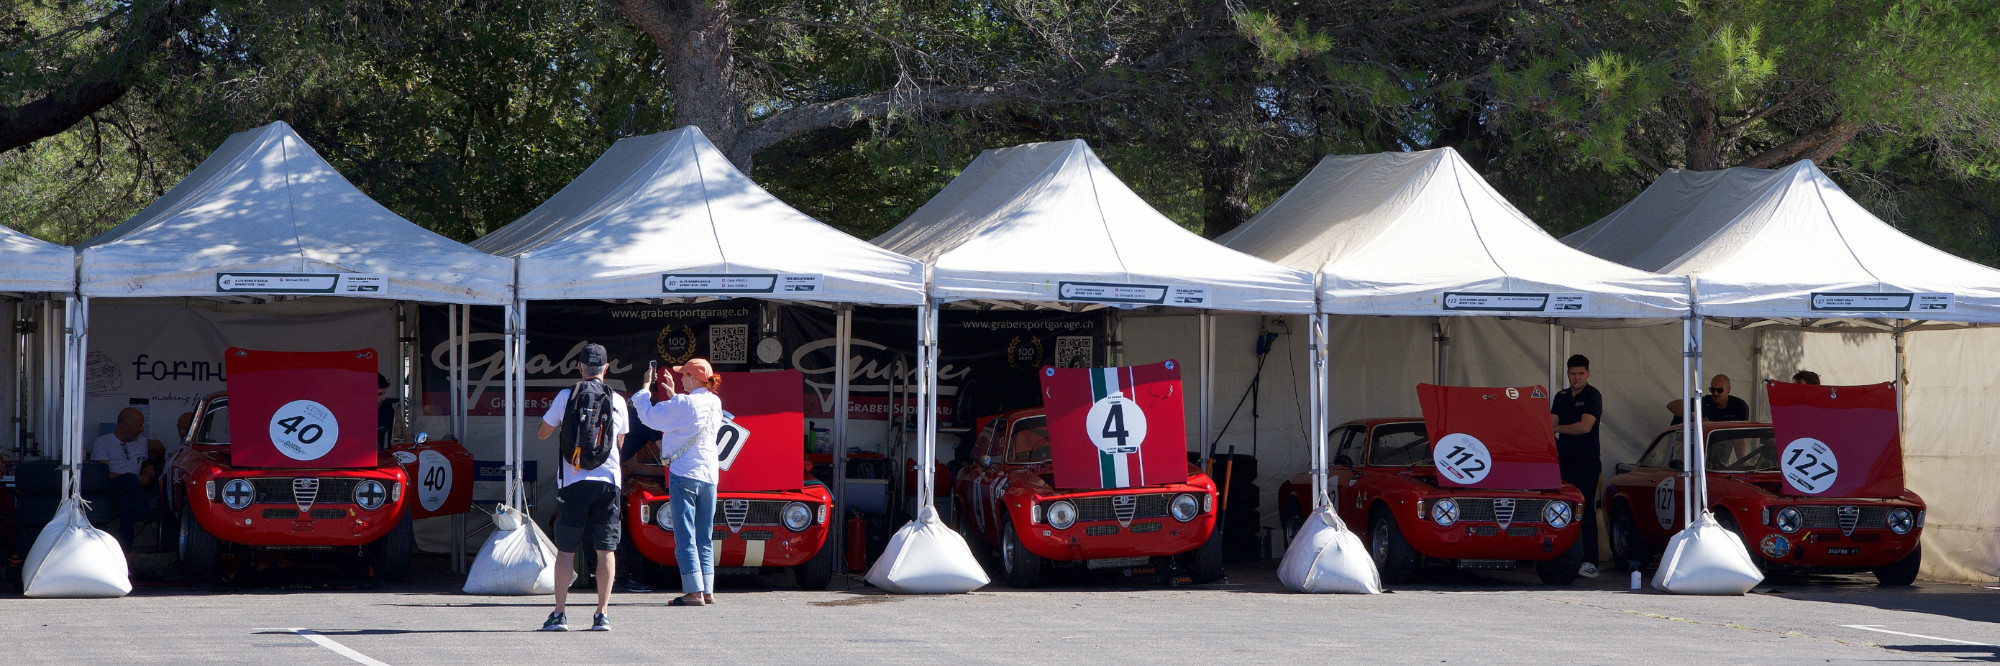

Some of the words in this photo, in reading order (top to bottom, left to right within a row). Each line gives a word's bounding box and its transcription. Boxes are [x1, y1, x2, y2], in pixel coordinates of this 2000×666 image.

[611, 306, 749, 319] www.grabersportgarage.ch
[963, 320, 1094, 331] www.grabersportgarage.ch
[667, 337, 686, 346] 100
[1017, 348, 1035, 356] 100
[848, 401, 889, 413] GRABER
[277, 415, 323, 444] 40
[1102, 404, 1129, 446] 4
[1446, 445, 1486, 479] 112
[1787, 448, 1836, 481] 127
[424, 466, 446, 491] 40
[1657, 488, 1673, 510] 127
